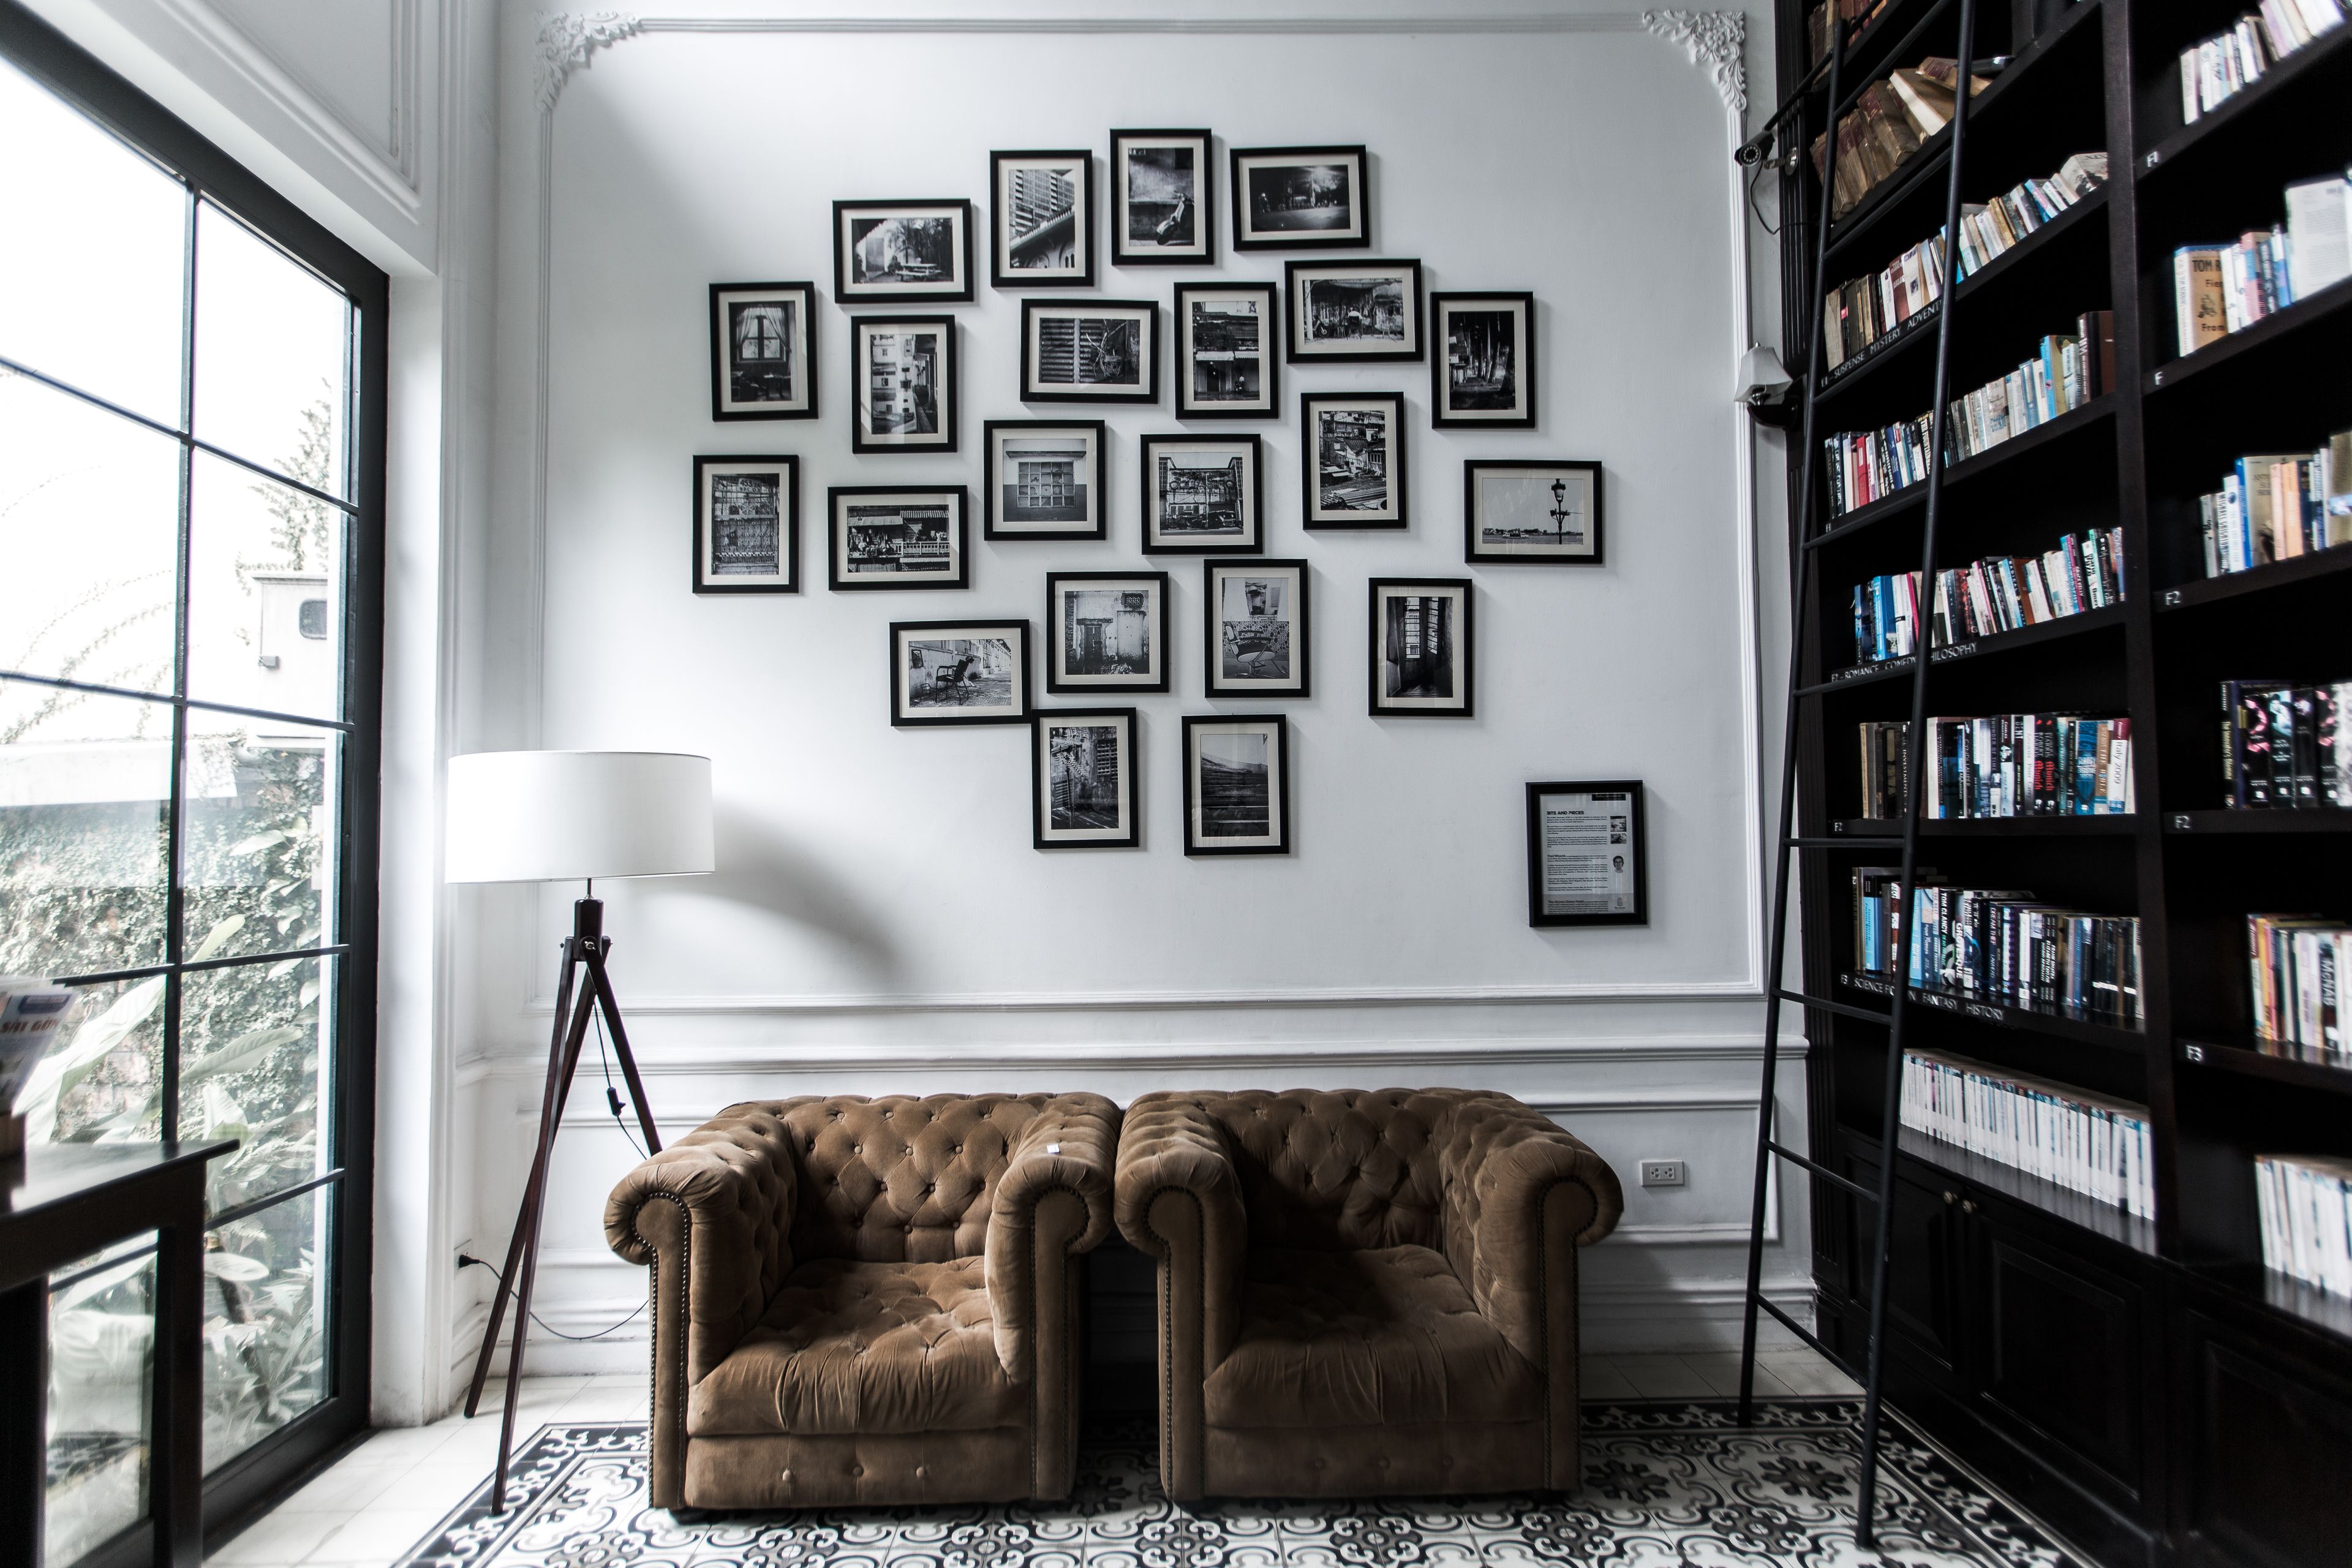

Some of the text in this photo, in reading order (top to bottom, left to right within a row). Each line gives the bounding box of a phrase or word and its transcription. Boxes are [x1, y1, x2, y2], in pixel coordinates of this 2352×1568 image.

[2192, 260, 2212, 272] TOM
[1834, 352, 1866, 380] SUSPENSE
[1870, 326, 1901, 355] MYSTERY
[1906, 300, 1942, 331] ADVENT
[2113, 529, 2124, 556] COAST
[2008, 560, 2018, 592] RADICAL
[2165, 590, 2181, 606] F2
[1844, 664, 1879, 679] ROMANCE
[1930, 643, 1977, 662] HILOSOPHY
[2034, 761, 2043, 790] Munich
[2045, 761, 2055, 791] Munich
[2113, 742, 2124, 785] Italy 2009
[1834, 822, 1842, 832] F2
[2174, 815, 2190, 829] F2
[1955, 922, 1964, 979] GROTESQUE
[2320, 959, 2336, 1006] McNAB
[1854, 978, 1883, 994] SCIENCE
[1923, 992, 1958, 1010] FANTASY
[1966, 1001, 2004, 1021] HISTORY
[2184, 1044, 2203, 1061] F3
